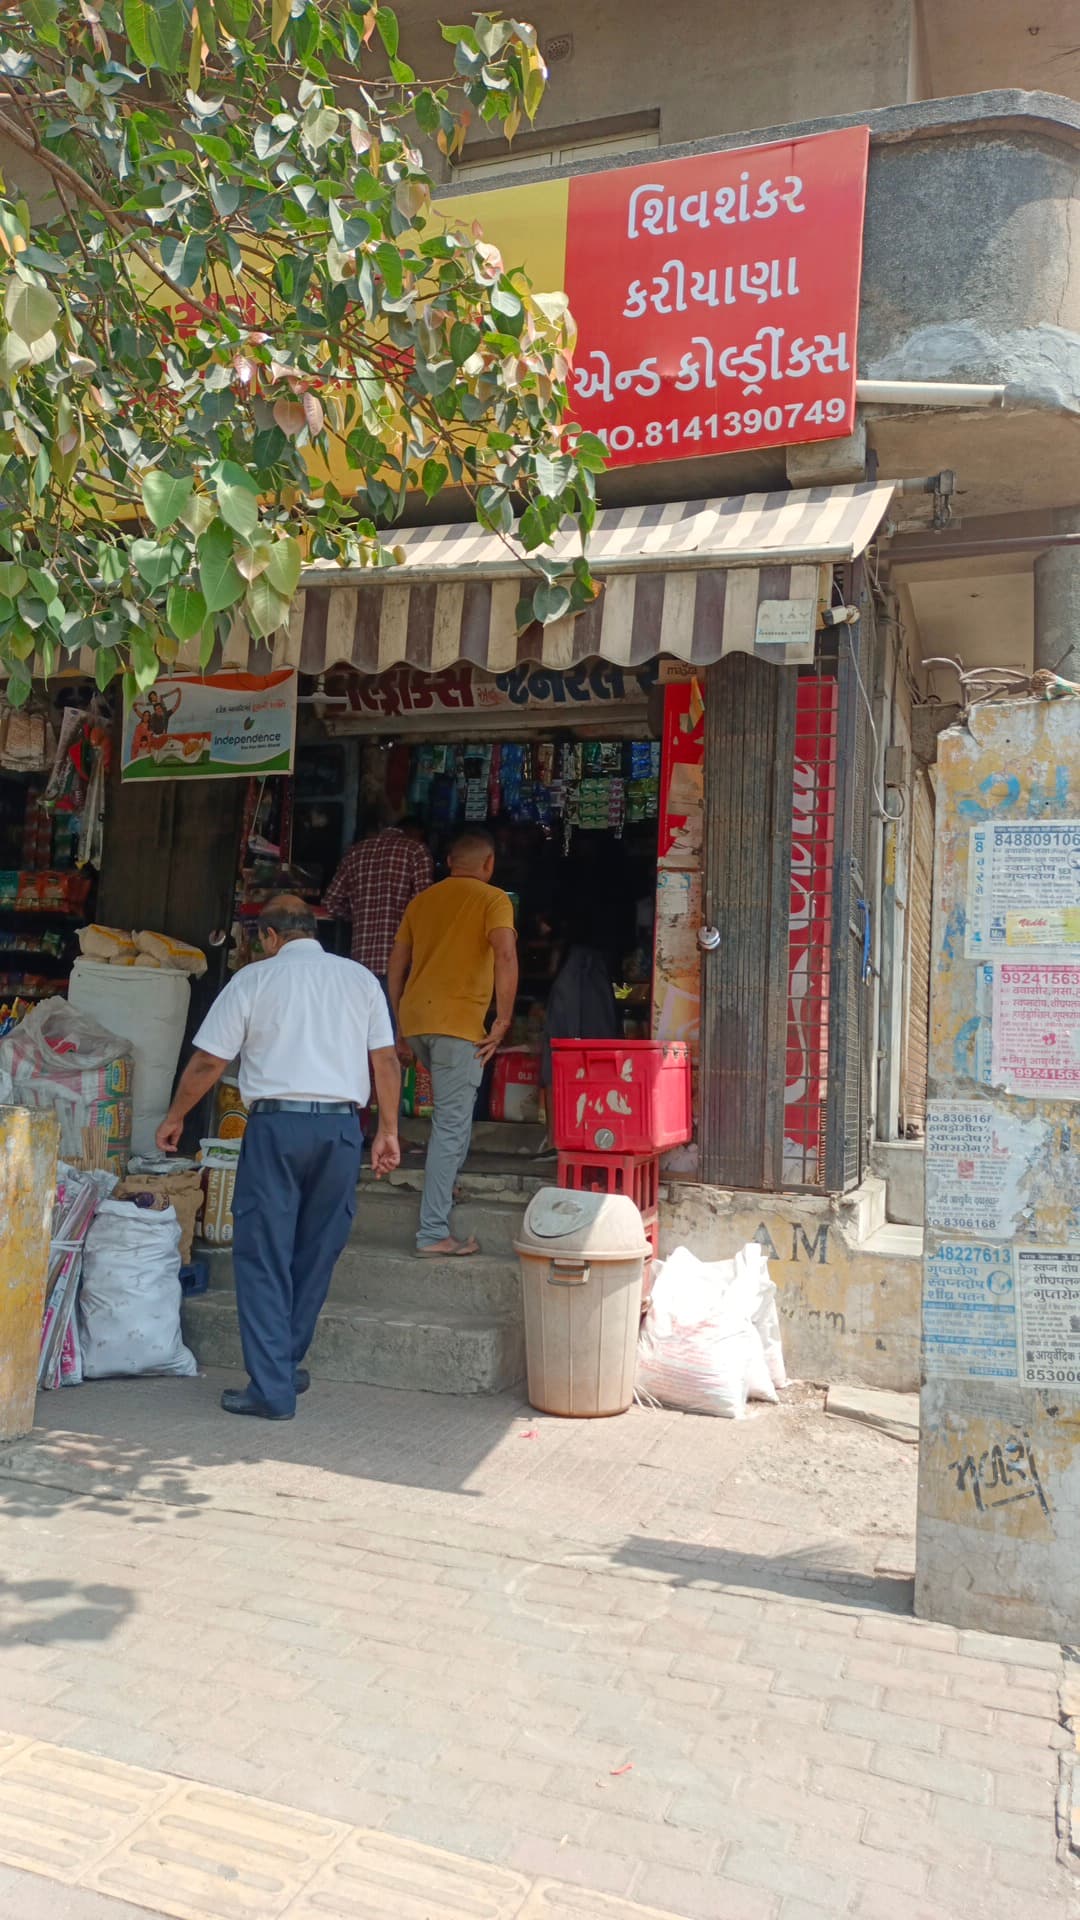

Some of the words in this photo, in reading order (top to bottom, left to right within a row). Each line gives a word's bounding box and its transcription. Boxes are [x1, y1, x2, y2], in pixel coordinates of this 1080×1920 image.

[627, 171, 806, 239] શિવશંકર
[622, 256, 799, 318] કરીયાણા
[573, 350, 661, 402] એન્ડ
[214, 733, 281, 747] Independence
[927, 1262, 978, 1277] गुप्तरोग
